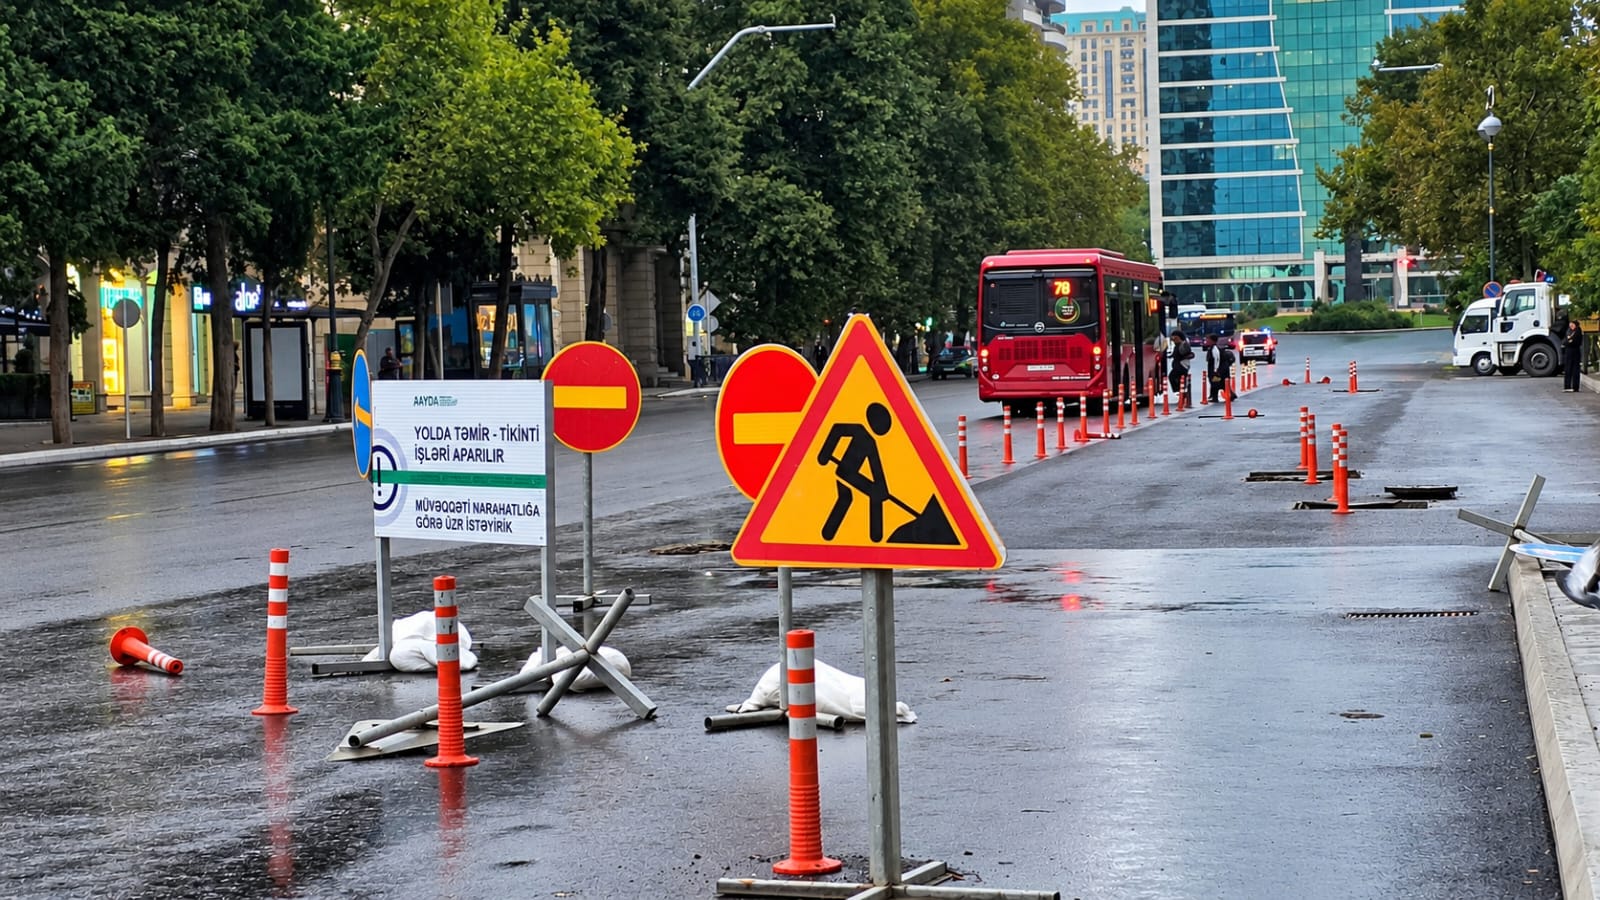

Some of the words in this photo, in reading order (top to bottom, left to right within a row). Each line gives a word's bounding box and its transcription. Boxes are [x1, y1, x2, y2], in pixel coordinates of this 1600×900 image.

[1053, 281, 1071, 295] 78
[413, 396, 439, 406] AAYDA
[414, 426, 452, 440] YOLDA
[454, 423, 490, 441] TƏMİR
[500, 424, 540, 442] TİKİNTİ
[414, 444, 450, 464] İŞLƏRİ
[452, 448, 504, 463] APARILIR
[415, 497, 470, 514] MÜVƏQQƏTİ
[473, 502, 540, 517] NARAHATLIĞA
[416, 514, 442, 529] GÖRƏ
[445, 515, 463, 530] ÜZR
[466, 516, 513, 533] İSTƏYİRİK
